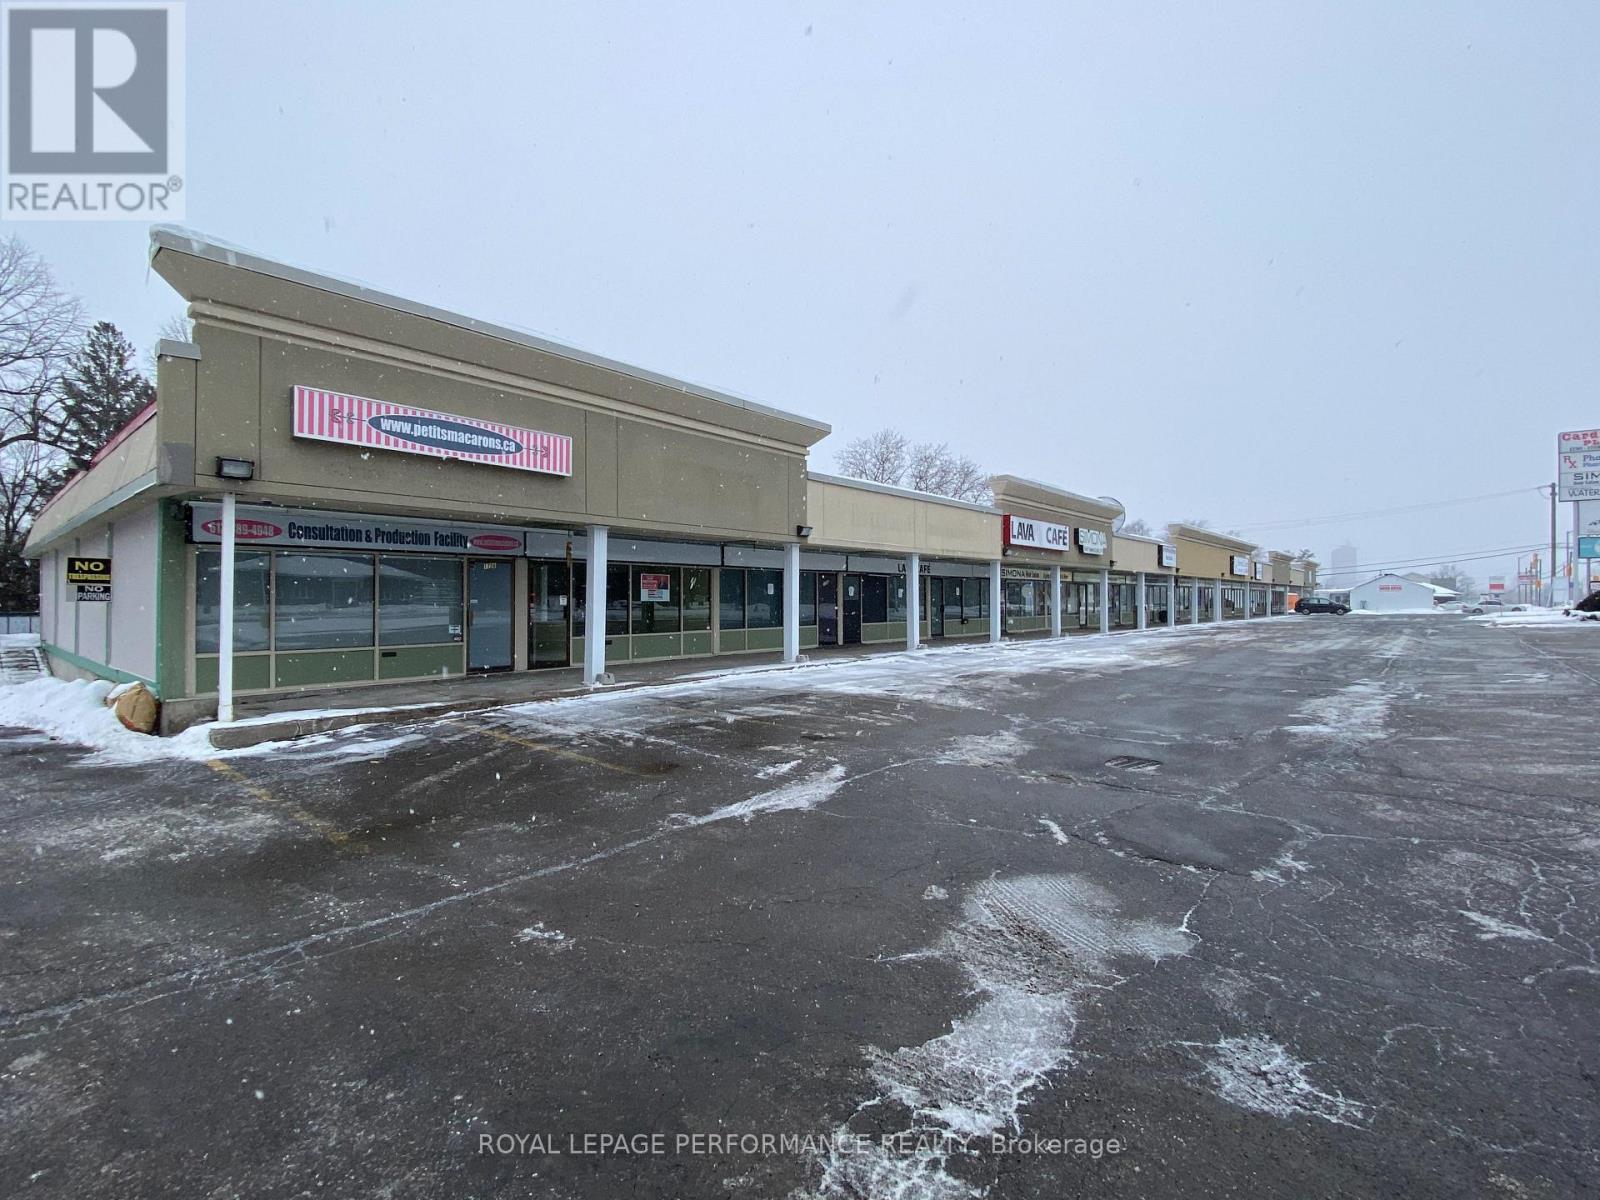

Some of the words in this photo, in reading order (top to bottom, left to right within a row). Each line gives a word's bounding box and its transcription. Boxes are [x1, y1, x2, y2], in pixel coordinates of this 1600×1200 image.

[380, 417, 516, 452] www.petitsmacarons.ca
[288, 521, 363, 543] Consultation
[365, 530, 373, 543] &
[374, 527, 431, 546] Production
[433, 531, 469, 549] Facility
[1011, 520, 1035, 542] LAVA
[74, 561, 105, 571] NO
[1001, 568, 1025, 578] SIMONA
[78, 592, 111, 601] PARKING
